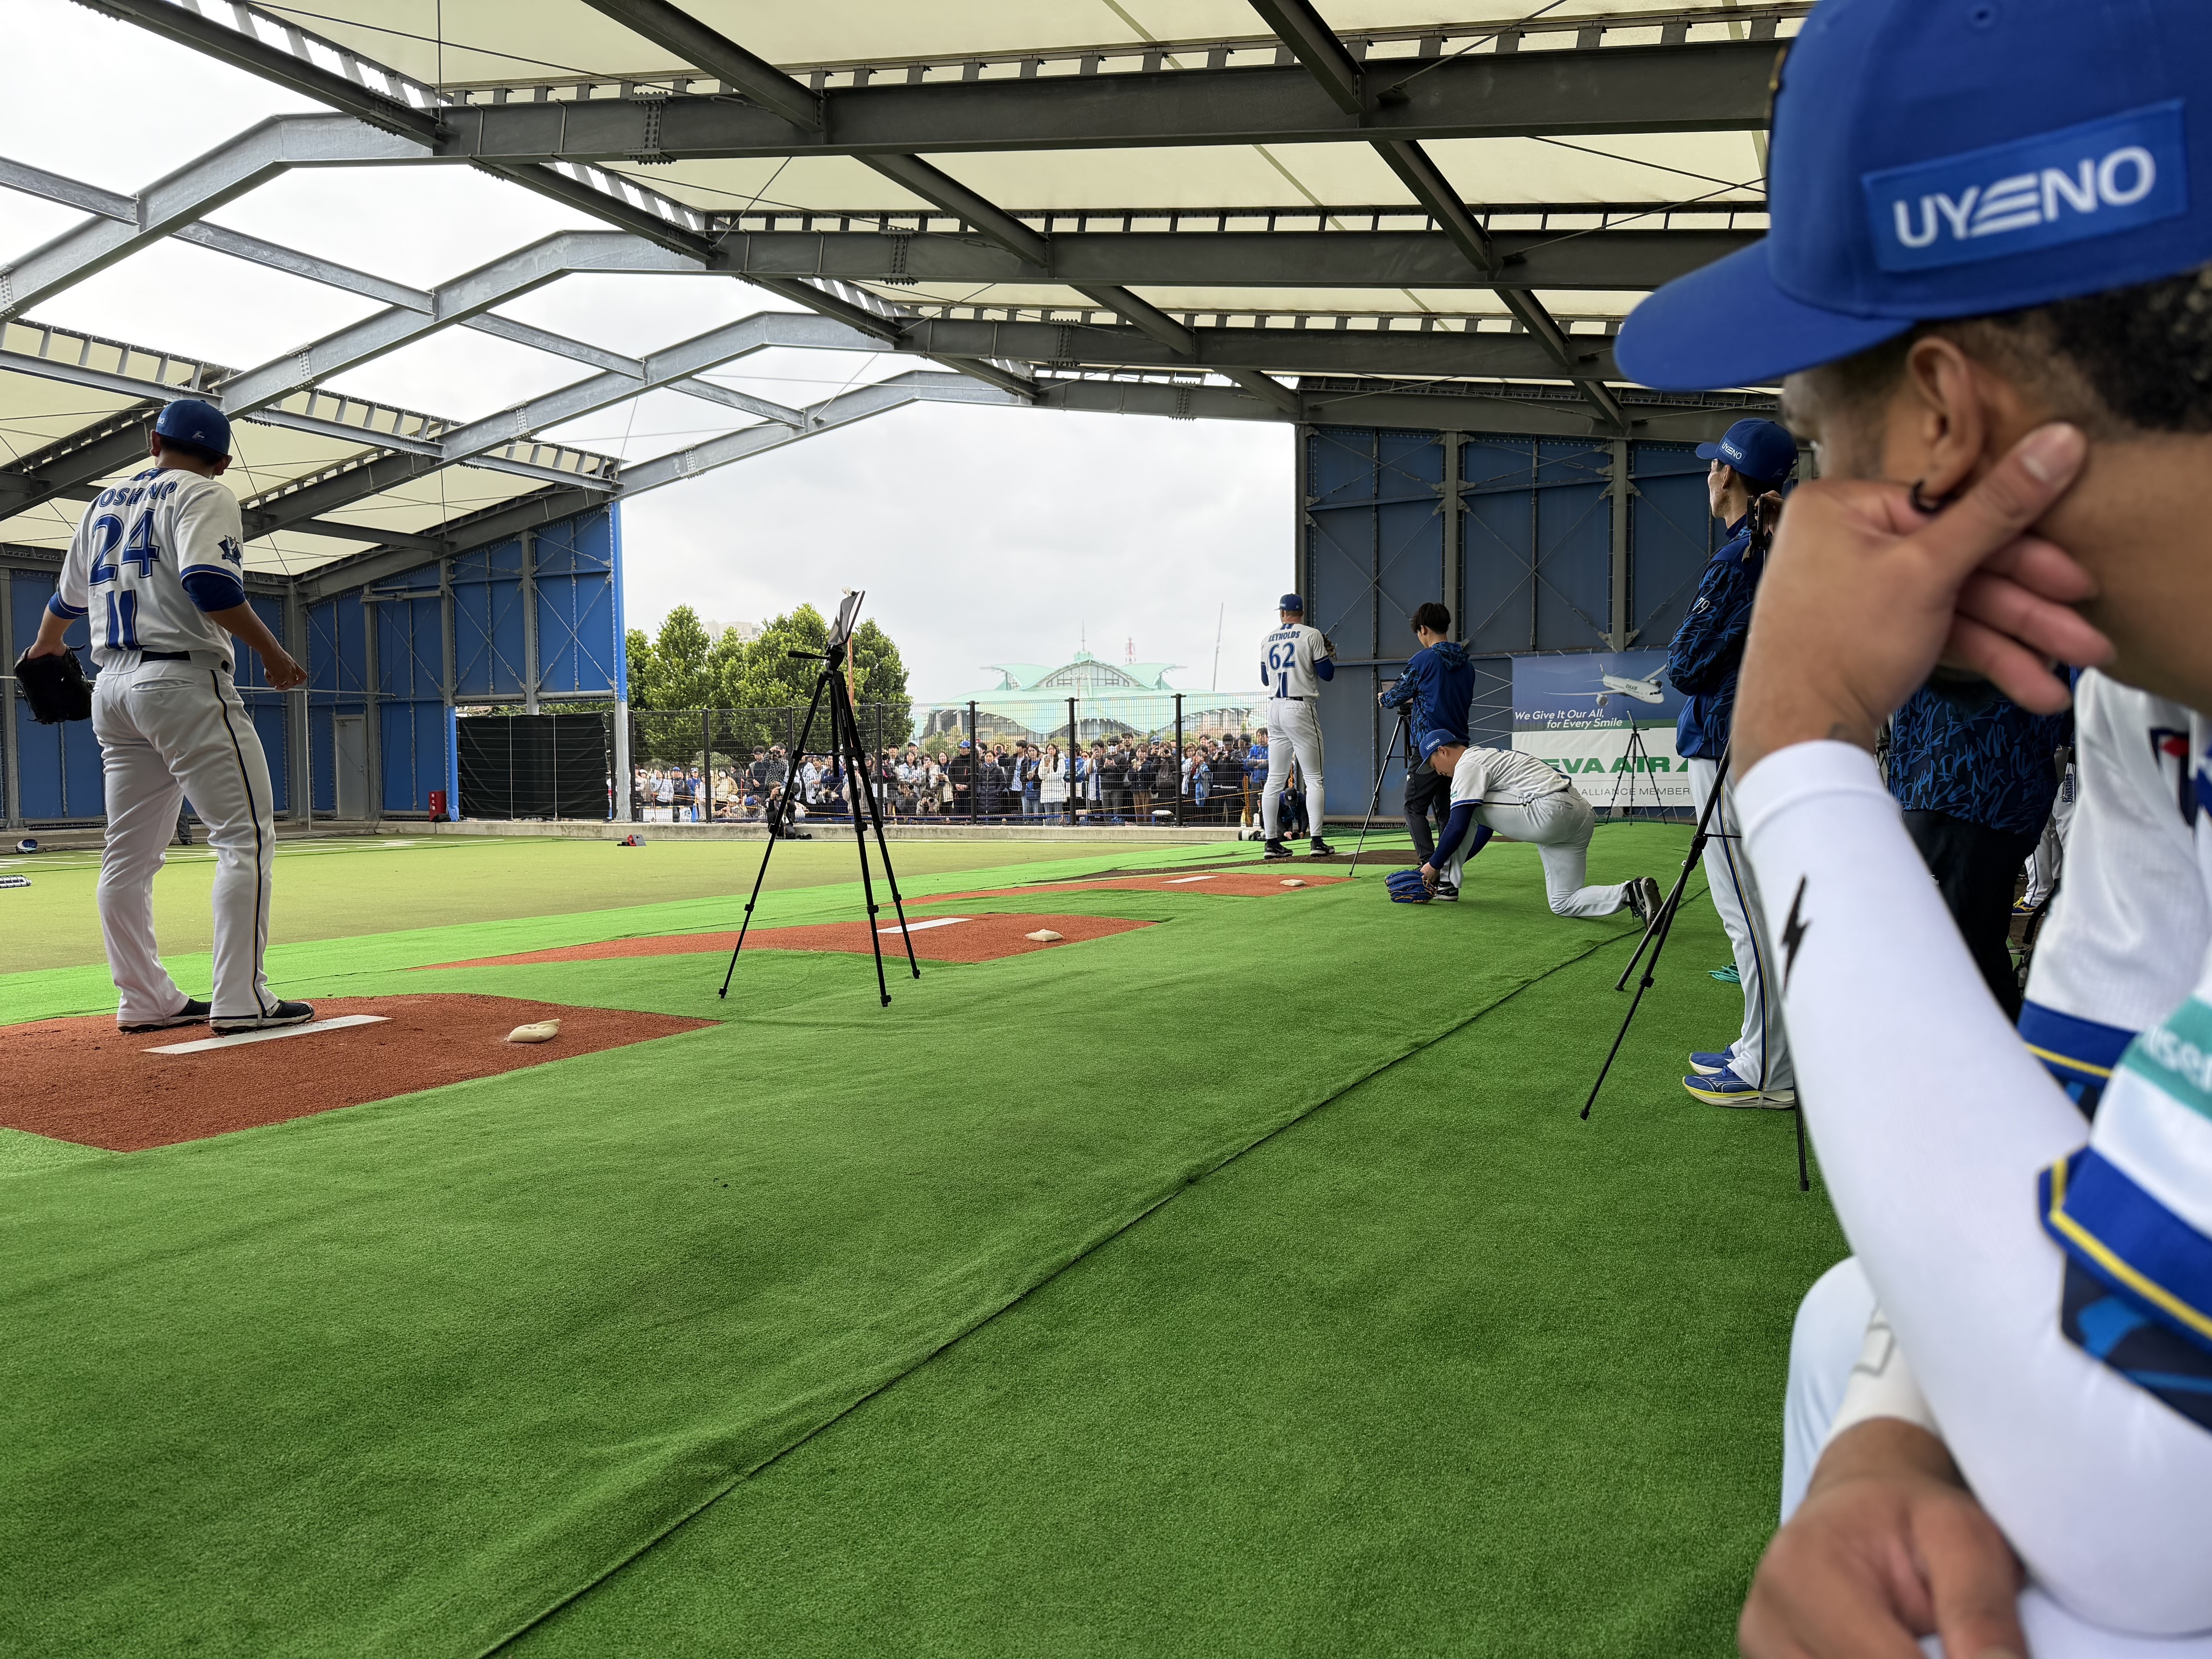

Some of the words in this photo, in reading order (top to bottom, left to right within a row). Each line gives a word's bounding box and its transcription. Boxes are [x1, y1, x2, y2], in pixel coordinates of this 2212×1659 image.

[1893, 146, 2157, 247] UYENO
[1722, 441, 1742, 460] UYENO
[89, 508, 160, 586] 24
[1269, 641, 1295, 670] 62
[1515, 712, 1530, 720] We
[1533, 711, 1555, 720] Give
[1557, 710, 1566, 719] It
[1567, 710, 1587, 718] Our
[1588, 708, 1604, 718] All,
[1547, 720, 1561, 728] for
[1563, 719, 1591, 729] Every
[1594, 718, 1623, 727] Smile
[1609, 757, 1670, 773] AIR
[1582, 788, 1635, 796] ALLIANCE
[1640, 787, 1690, 795] MEMBER
